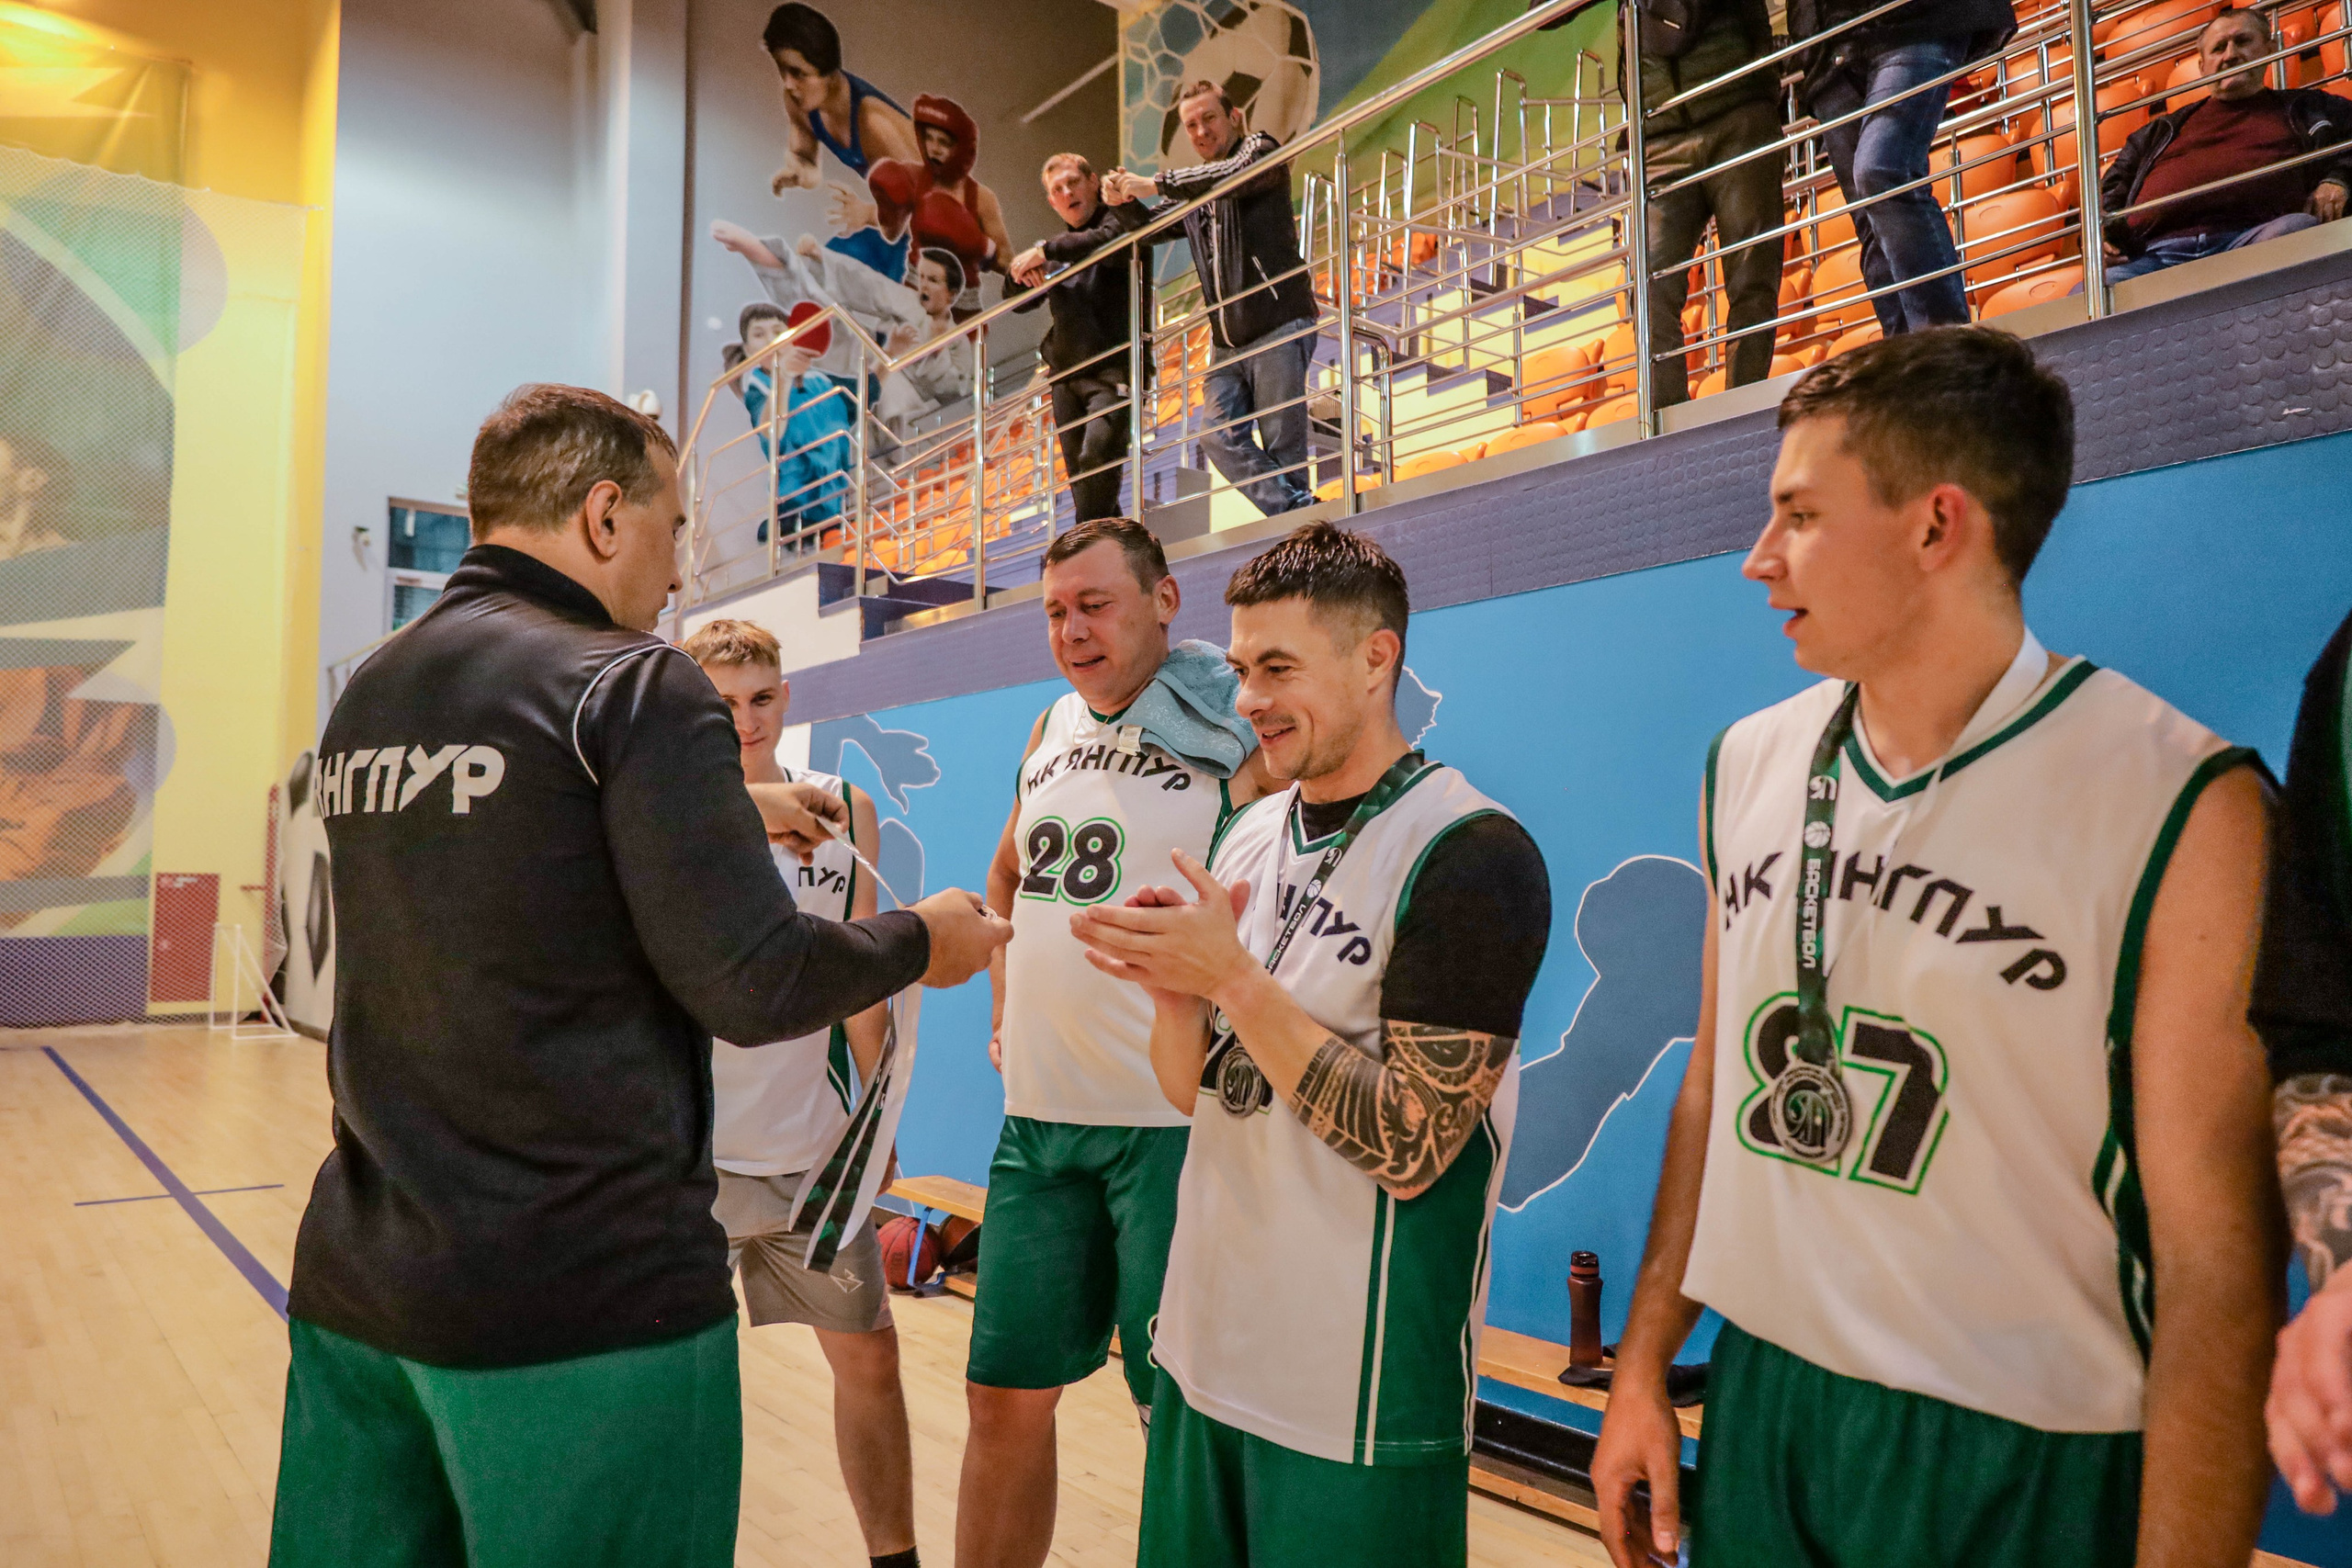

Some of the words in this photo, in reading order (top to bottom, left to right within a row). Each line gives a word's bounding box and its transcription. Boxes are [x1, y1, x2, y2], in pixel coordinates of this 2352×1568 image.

[797, 866, 846, 894] ПУР
[1020, 816, 1125, 907] 28
[1268, 903, 1307, 972] АСКЕТБОЛ
[1829, 848, 2067, 991] НГПУР
